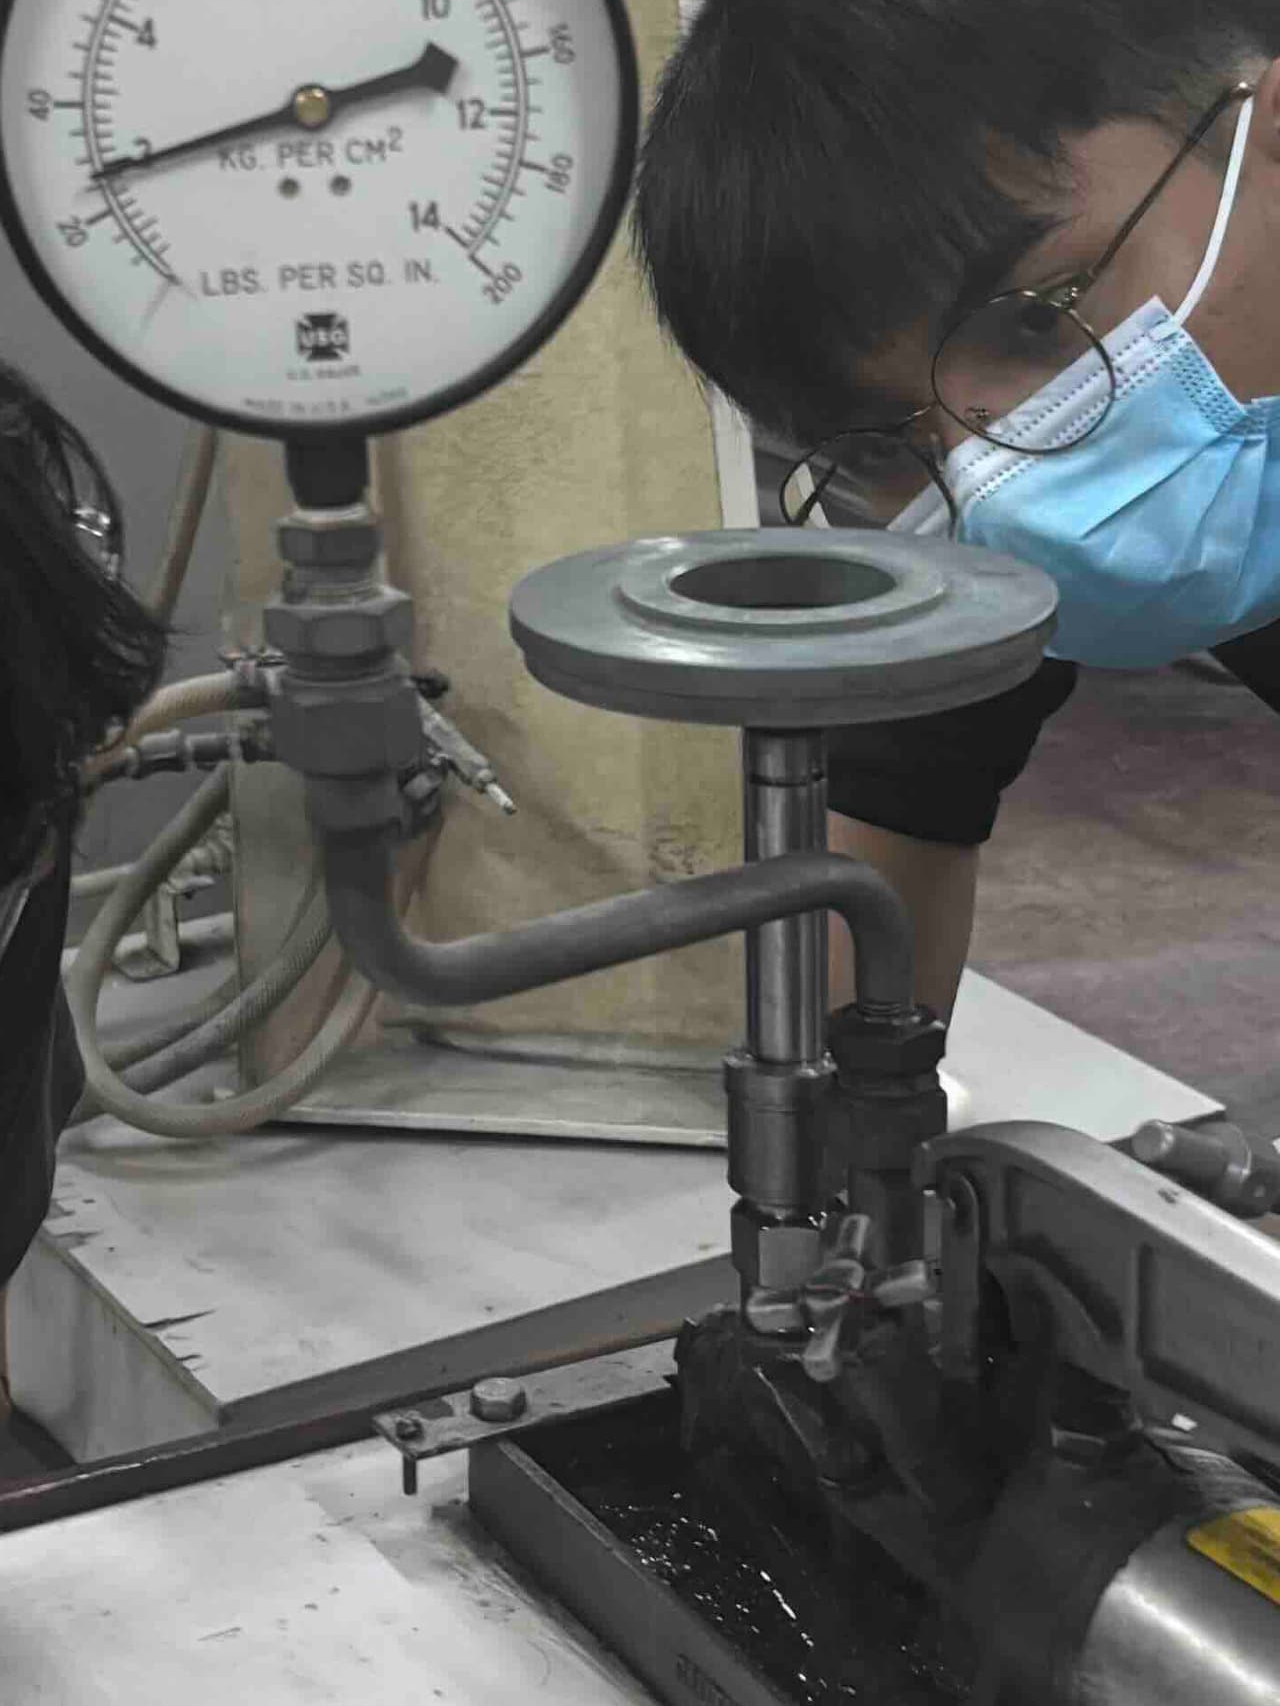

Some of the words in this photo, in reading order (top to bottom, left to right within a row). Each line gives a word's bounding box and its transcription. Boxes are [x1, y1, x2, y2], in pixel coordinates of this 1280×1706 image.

[134, 19, 158, 50] 4
[547, 23, 575, 66] 160
[29, 91, 51, 122] 40
[455, 99, 486, 131] 12
[218, 147, 264, 171] KG.
[277, 141, 334, 168] PER
[546, 152, 575, 194] 180
[57, 217, 88, 248] 20
[408, 200, 441, 234] 14
[199, 268, 265, 297] LBS.
[278, 262, 336, 291] PER
[347, 260, 393, 288] SQ.
[404, 258, 439, 284] IN.
[482, 264, 522, 305] 200
